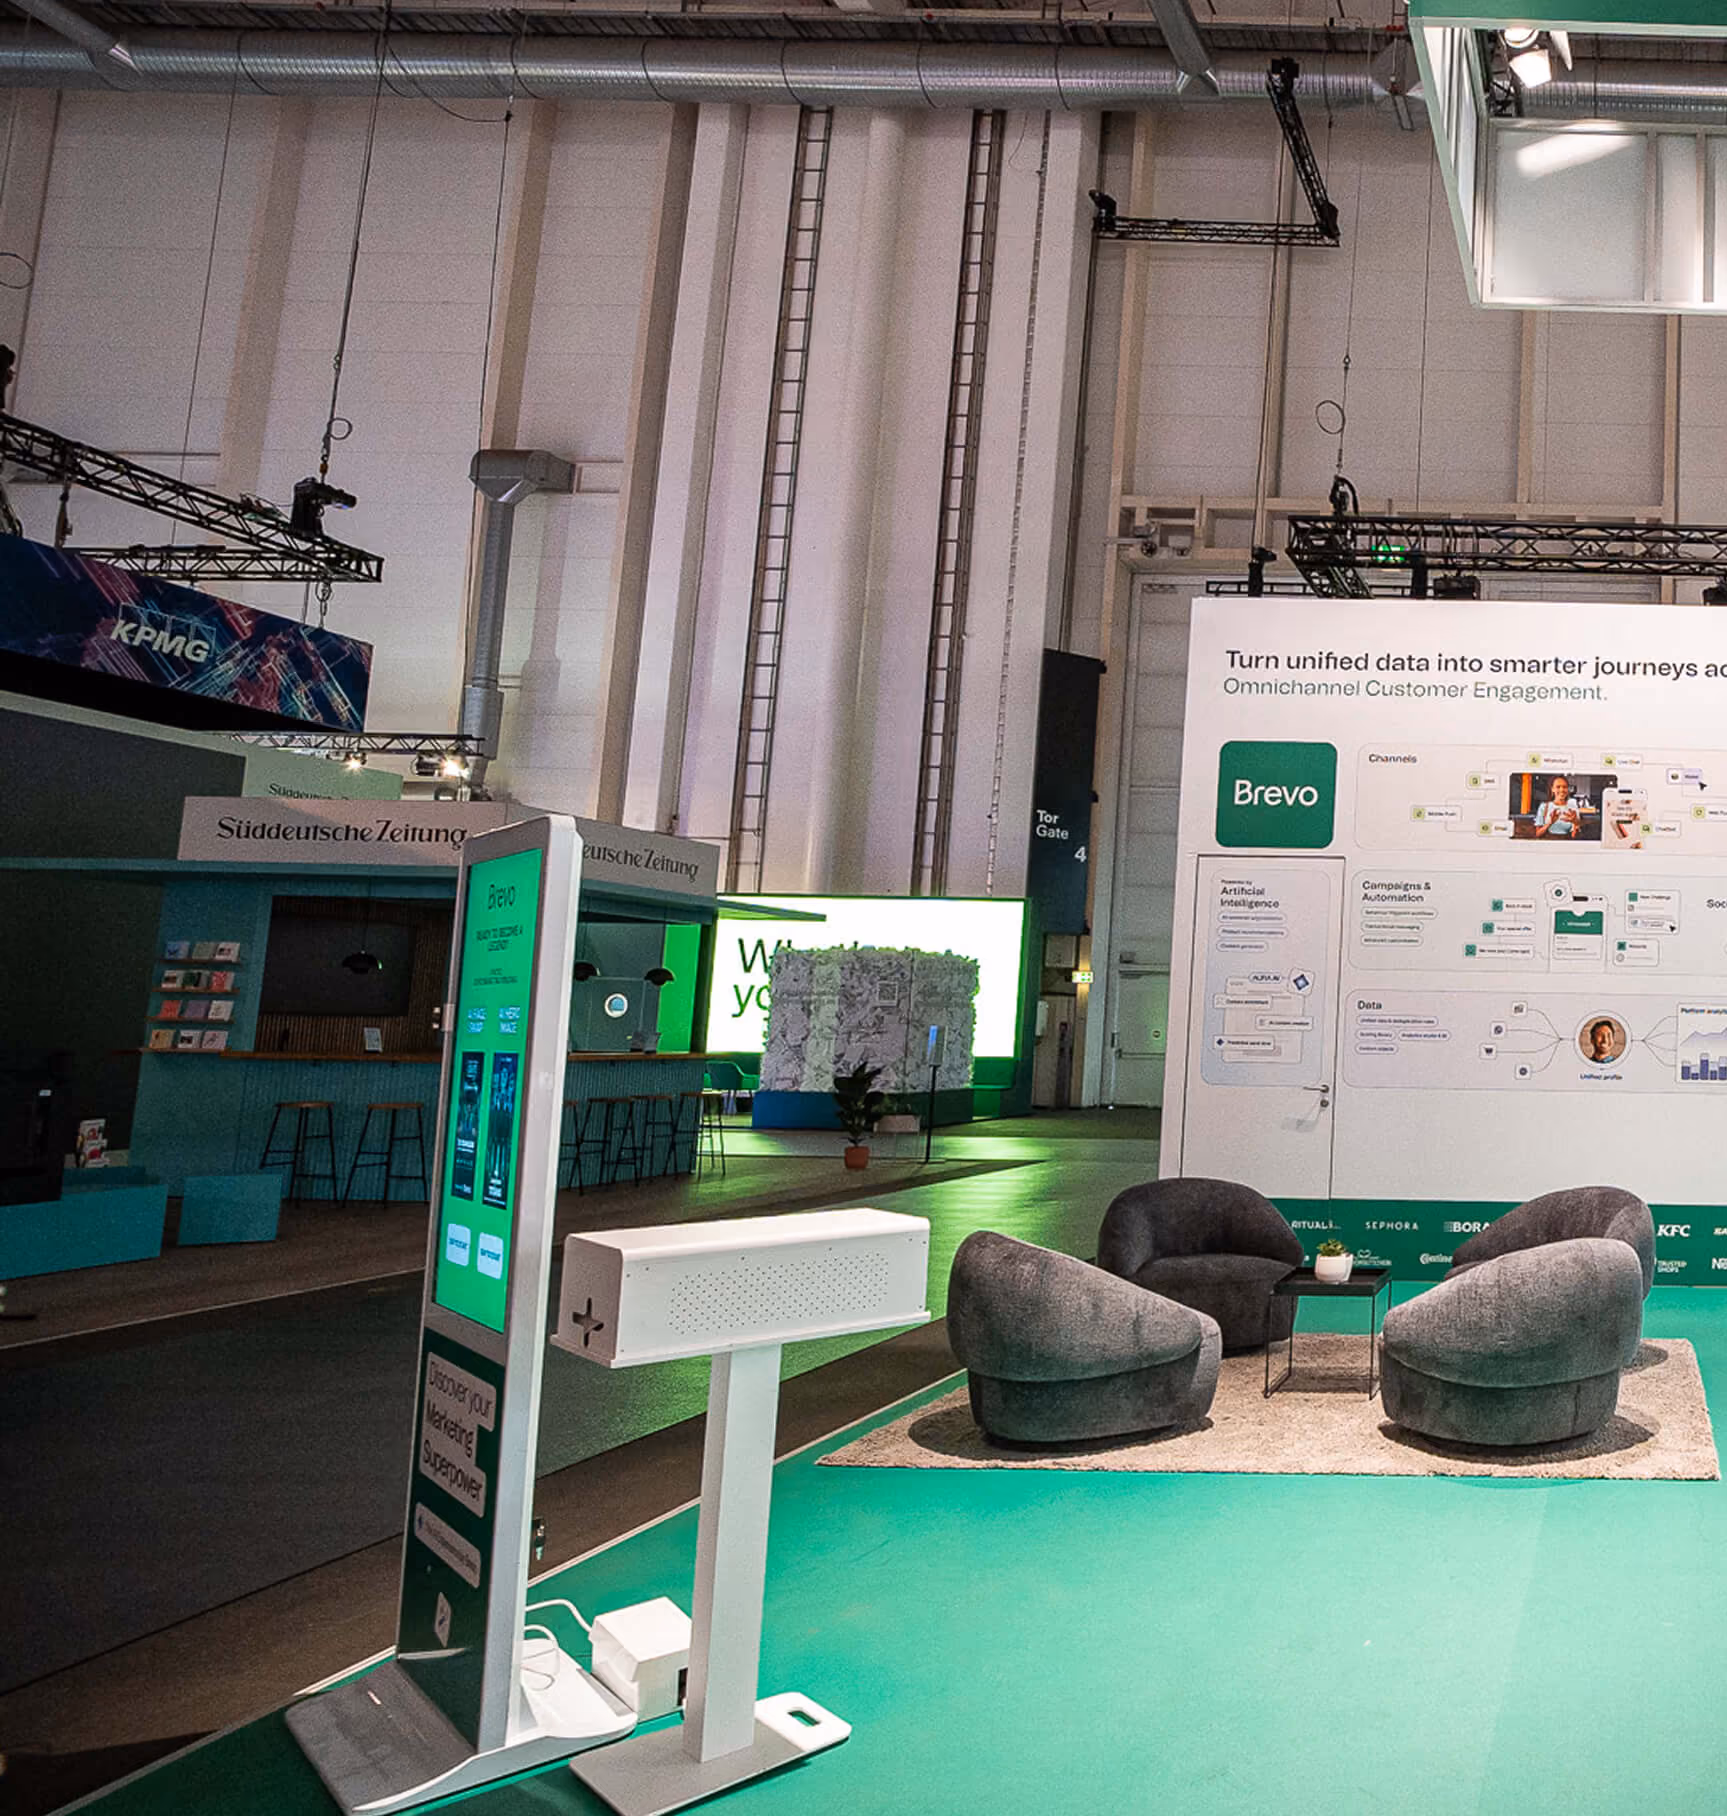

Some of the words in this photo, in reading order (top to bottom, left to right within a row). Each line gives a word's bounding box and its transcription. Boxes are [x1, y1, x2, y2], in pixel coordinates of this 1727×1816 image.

[110, 619, 210, 662] KPMG
[1226, 650, 1278, 671] Turn
[1286, 651, 1369, 672] unified
[1376, 653, 1430, 672] data
[1438, 653, 1483, 673] into
[1489, 656, 1587, 674] smarter
[1593, 656, 1698, 681] journeys
[1223, 677, 1361, 698] Omnichannel
[1365, 679, 1468, 698] Customer
[1473, 681, 1608, 703] Engagement.
[1368, 754, 1417, 764] Channels
[1234, 779, 1318, 806] Brevo
[1036, 809, 1059, 824] Tor
[217, 816, 372, 842] Süddeutsche
[376, 819, 468, 850] Zeitung
[1036, 824, 1069, 840] Gate
[1074, 846, 1087, 862] 4
[644, 849, 699, 883] Zeitung
[1220, 887, 1265, 896] Artificial
[1362, 881, 1421, 892] Campaigns
[1423, 882, 1431, 890] &
[488, 884, 516, 910] Brevo
[1220, 898, 1279, 909] Intelligence
[1362, 893, 1424, 902] Automation
[1357, 1000, 1382, 1010] Data
[1364, 1221, 1420, 1231] SEPHORA
[1657, 1224, 1691, 1237] KFC
[429, 1361, 468, 1404] Discover
[468, 1391, 492, 1419] your
[426, 1400, 474, 1458] Marketing
[422, 1439, 482, 1501] Superpower
